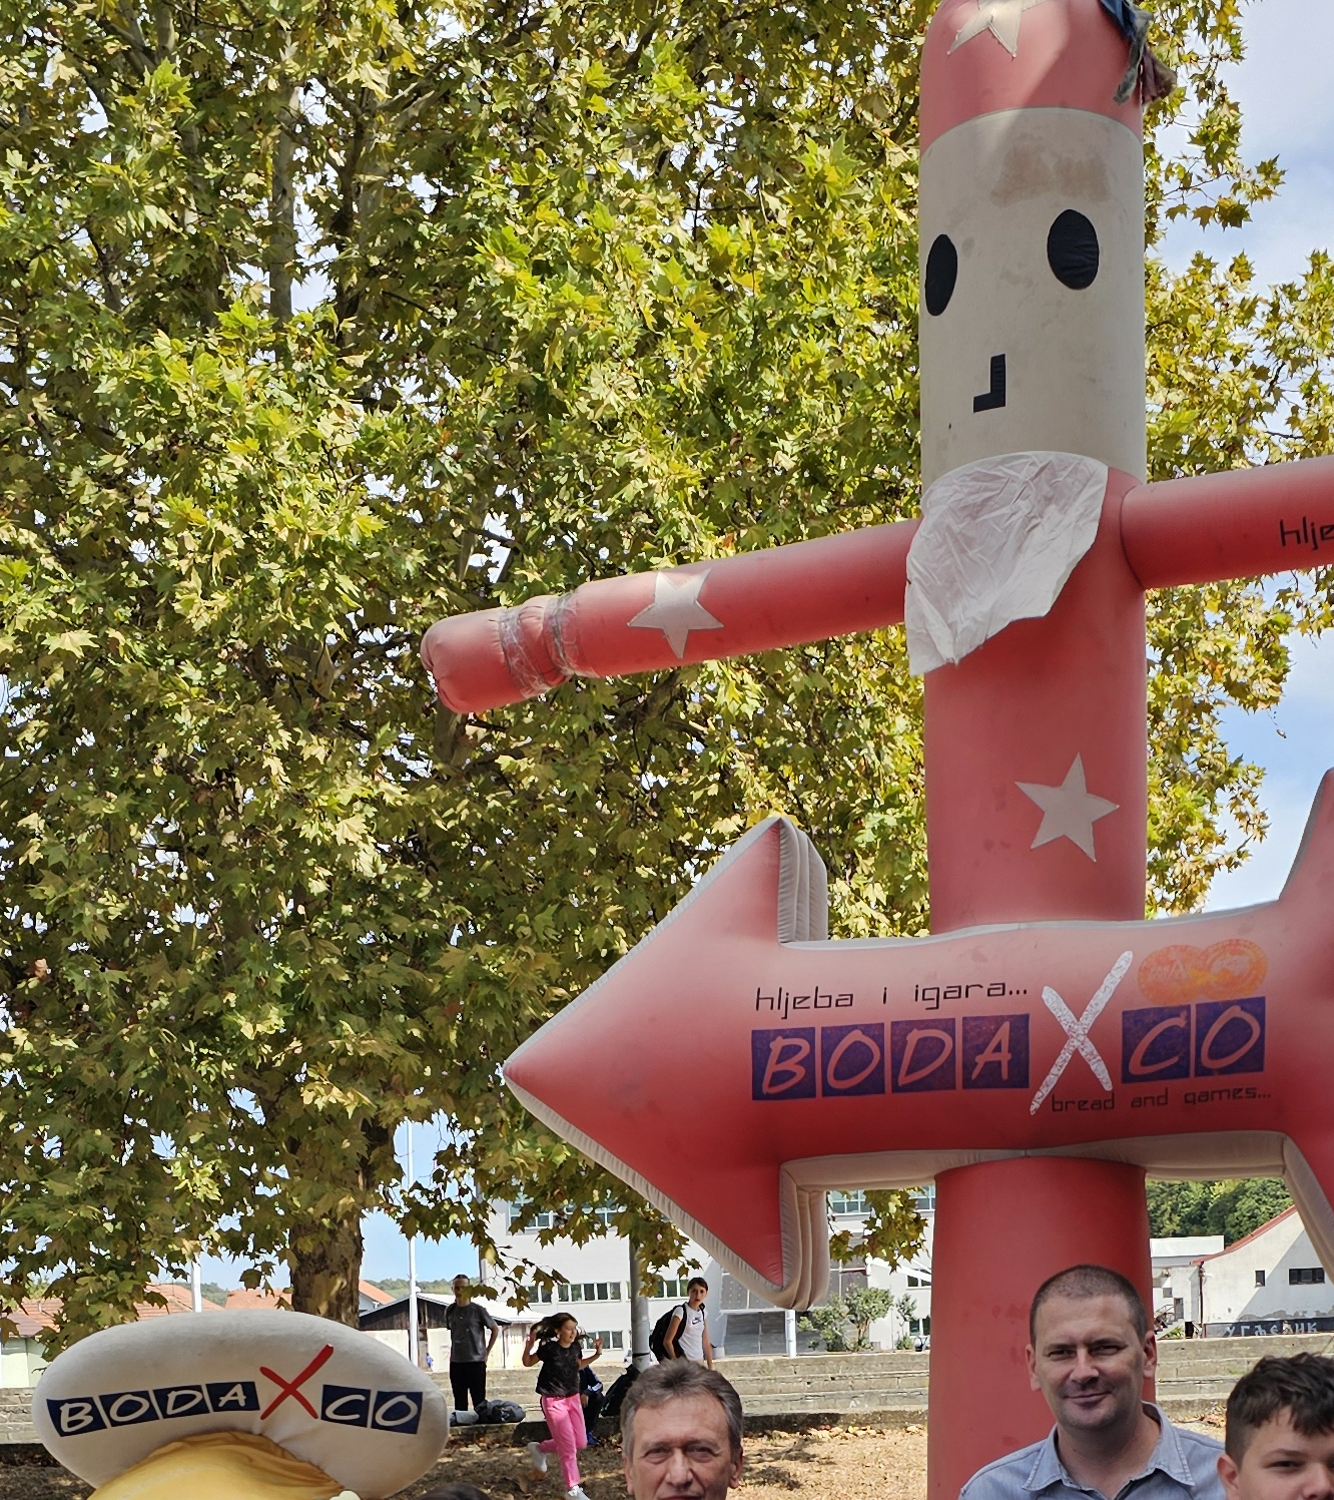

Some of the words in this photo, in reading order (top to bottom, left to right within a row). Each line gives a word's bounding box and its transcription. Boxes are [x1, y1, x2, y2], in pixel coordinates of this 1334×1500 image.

[753, 984, 855, 1020] hljeba
[881, 985, 889, 1005] i
[913, 983, 1029, 1010] igara...
[1052, 1091, 1116, 1113] bread
[1130, 1087, 1169, 1109] and
[1183, 1086, 1272, 1106] games...
